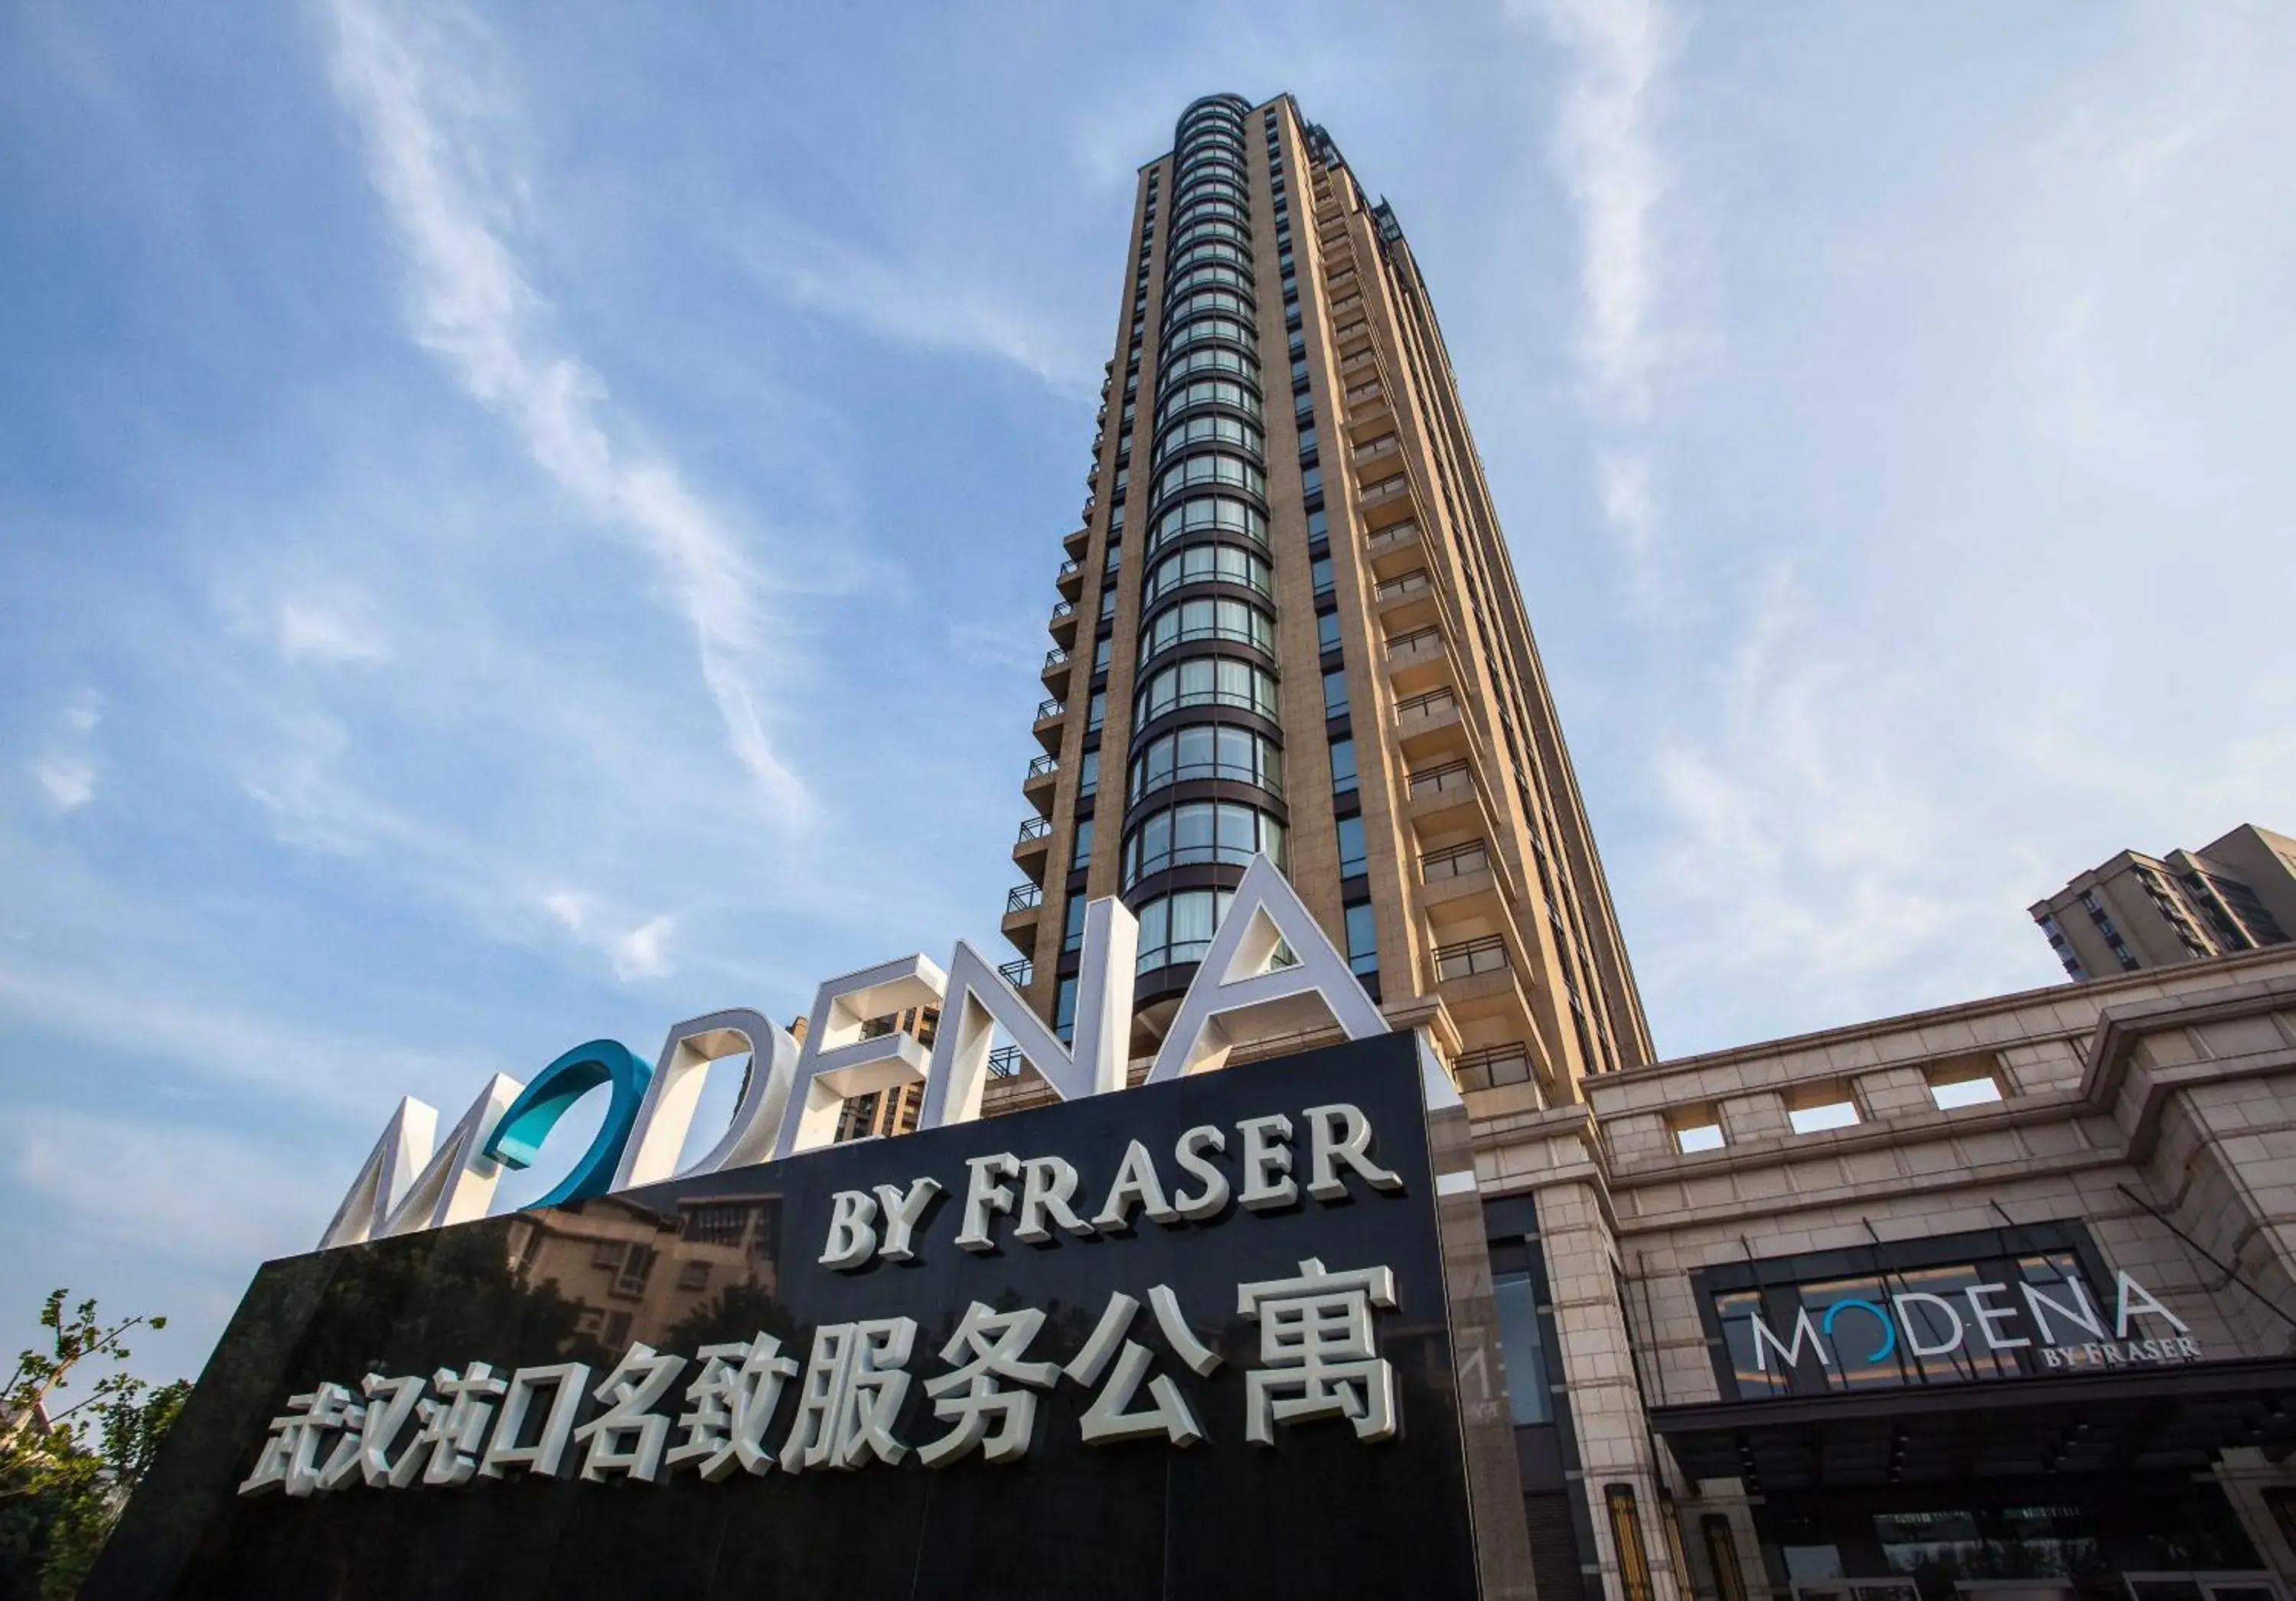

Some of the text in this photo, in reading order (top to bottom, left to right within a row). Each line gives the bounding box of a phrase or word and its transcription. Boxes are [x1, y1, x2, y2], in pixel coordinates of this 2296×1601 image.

[315, 852, 1393, 1252] MODENA
[817, 1103, 1404, 1271] BY FRASER
[1750, 1270, 2190, 1371] MODENA
[2042, 1336, 2203, 1368] BY FRASER
